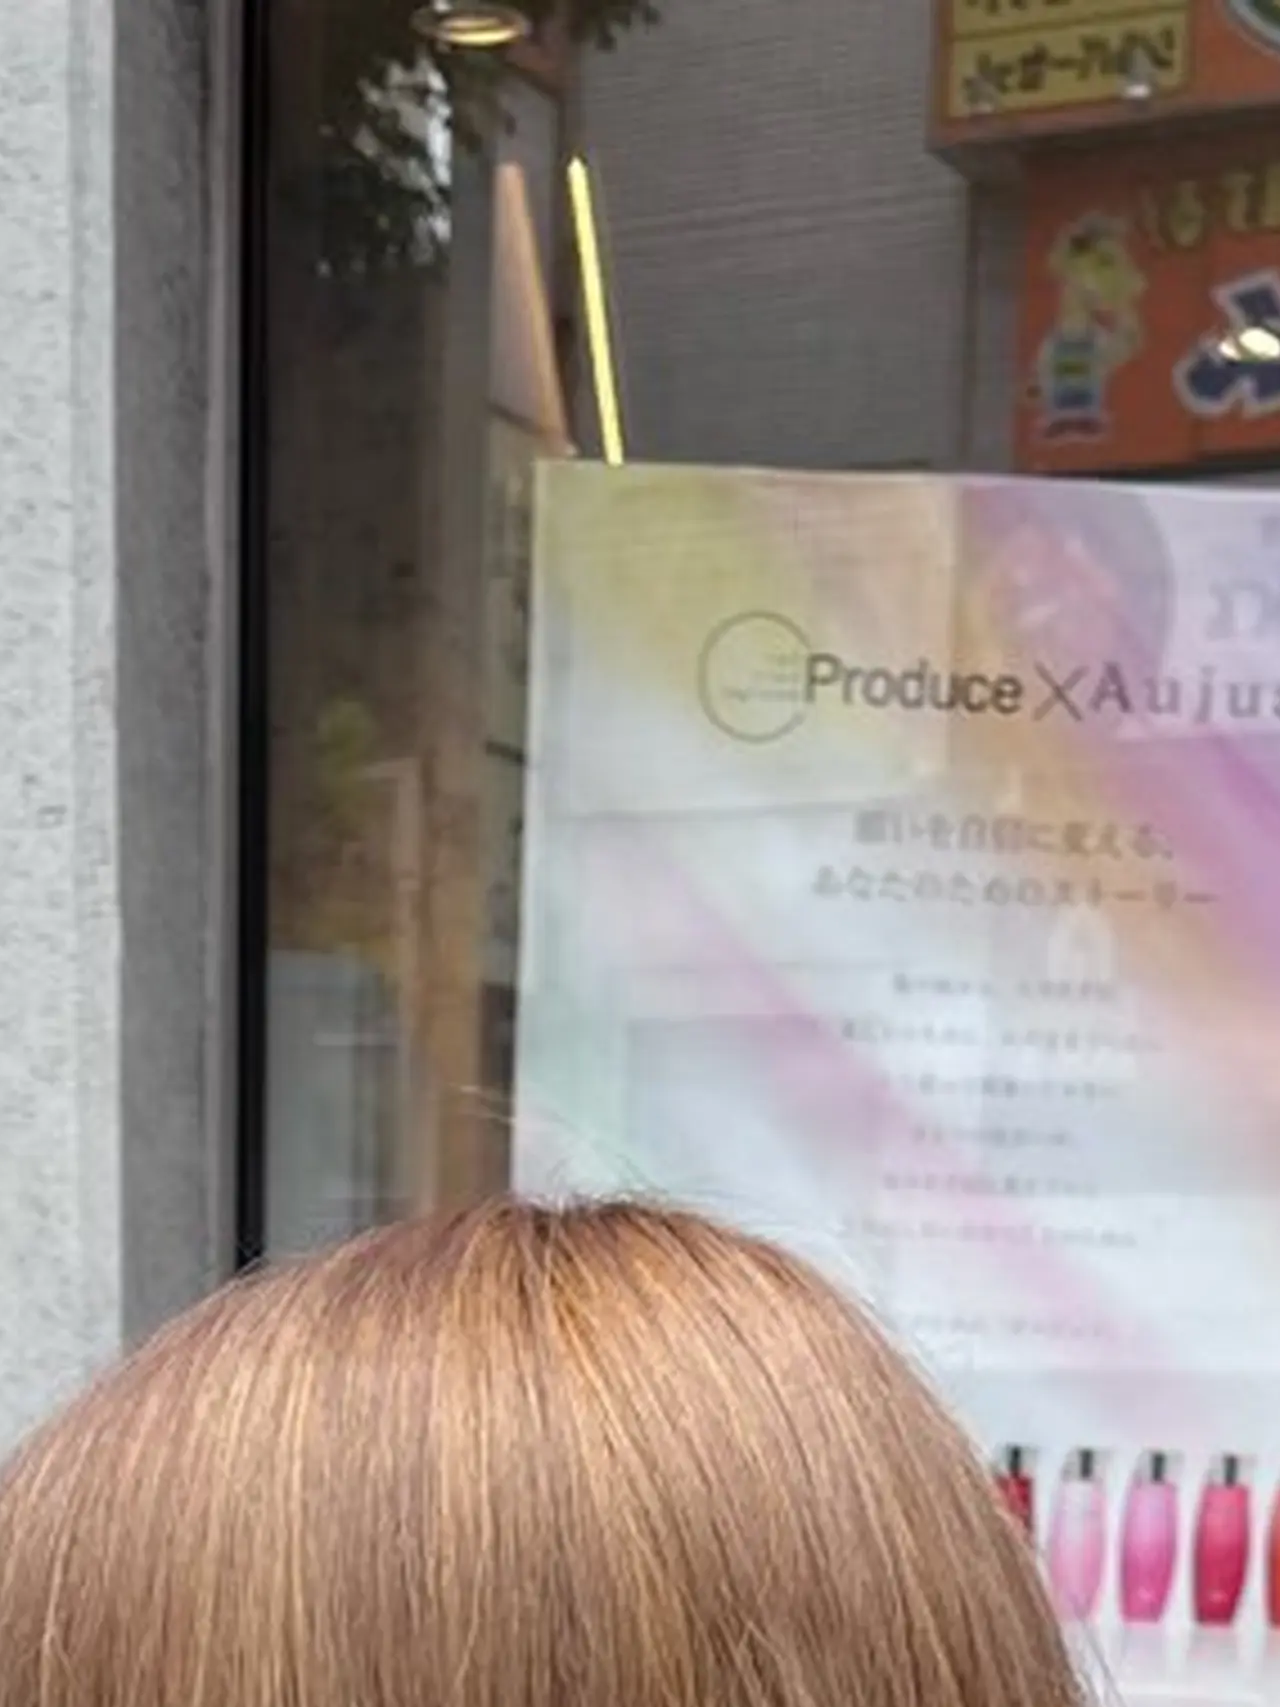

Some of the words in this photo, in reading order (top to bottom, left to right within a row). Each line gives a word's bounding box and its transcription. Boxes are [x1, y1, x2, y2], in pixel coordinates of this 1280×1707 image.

[804, 652, 1025, 715] Produce
[810, 864, 1220, 911] あなたのためのストーリー
